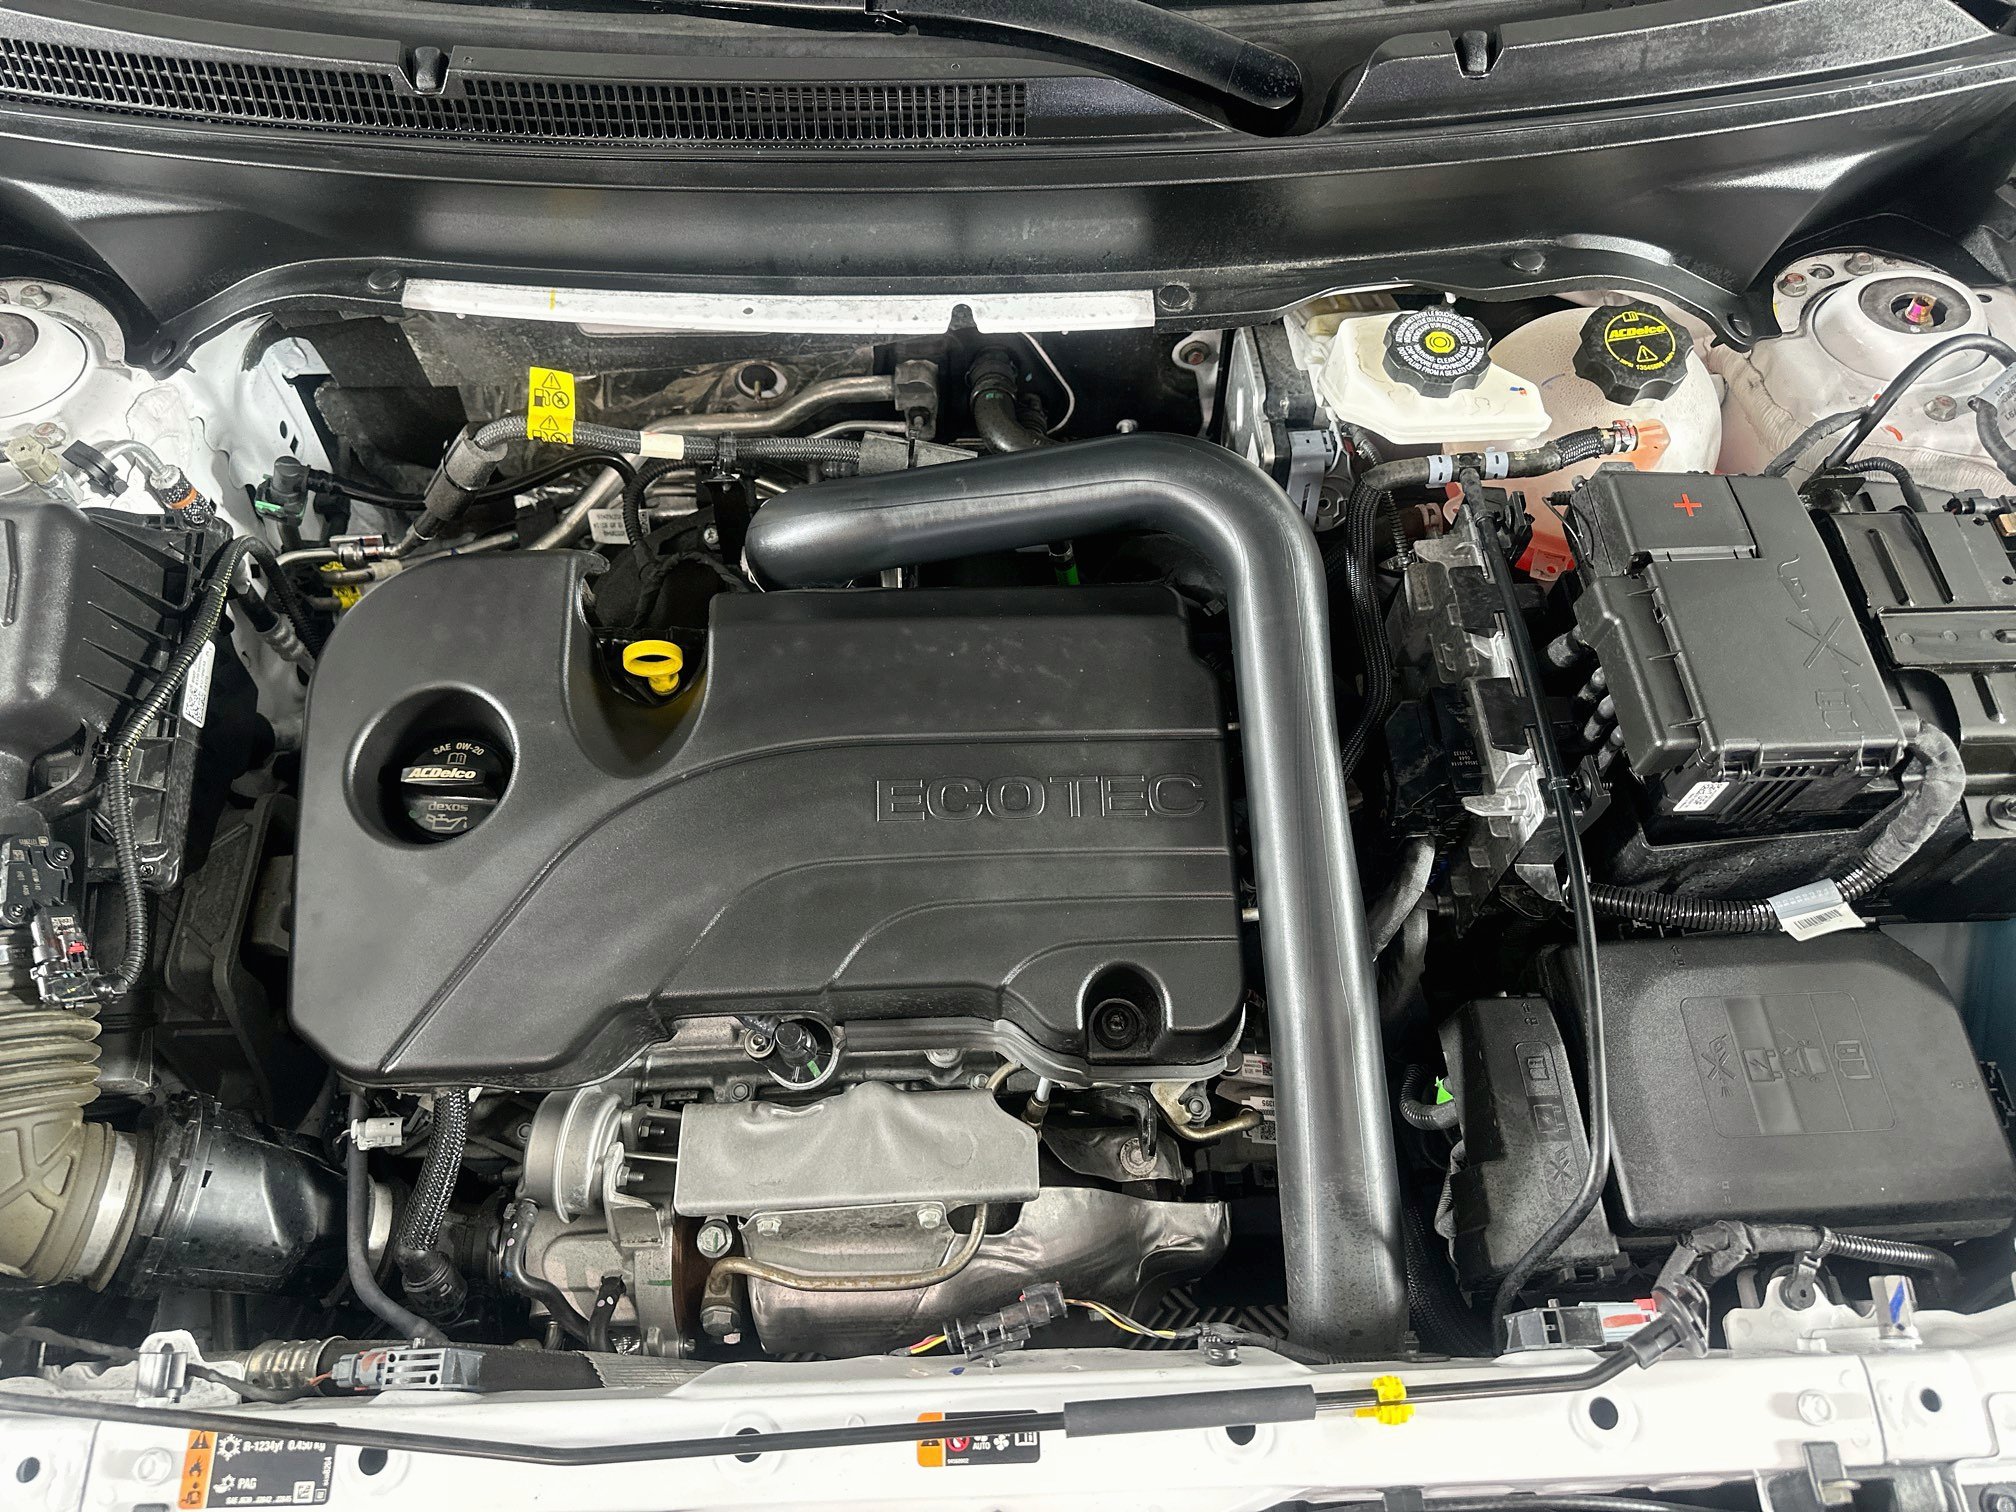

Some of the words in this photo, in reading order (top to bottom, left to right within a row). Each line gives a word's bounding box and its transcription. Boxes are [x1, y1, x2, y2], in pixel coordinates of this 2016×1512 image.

[1609, 326, 1666, 338] ACDelco
[1420, 366, 1439, 375] FROM
[433, 743, 451, 755] SAE
[456, 742, 485, 756] 0W-20
[408, 767, 476, 779] ACDelco
[876, 774, 1205, 821] ECOTEC
[428, 801, 469, 812] dexos
[972, 1441, 991, 1450] AUTO
[237, 1477, 257, 1490] PAG
